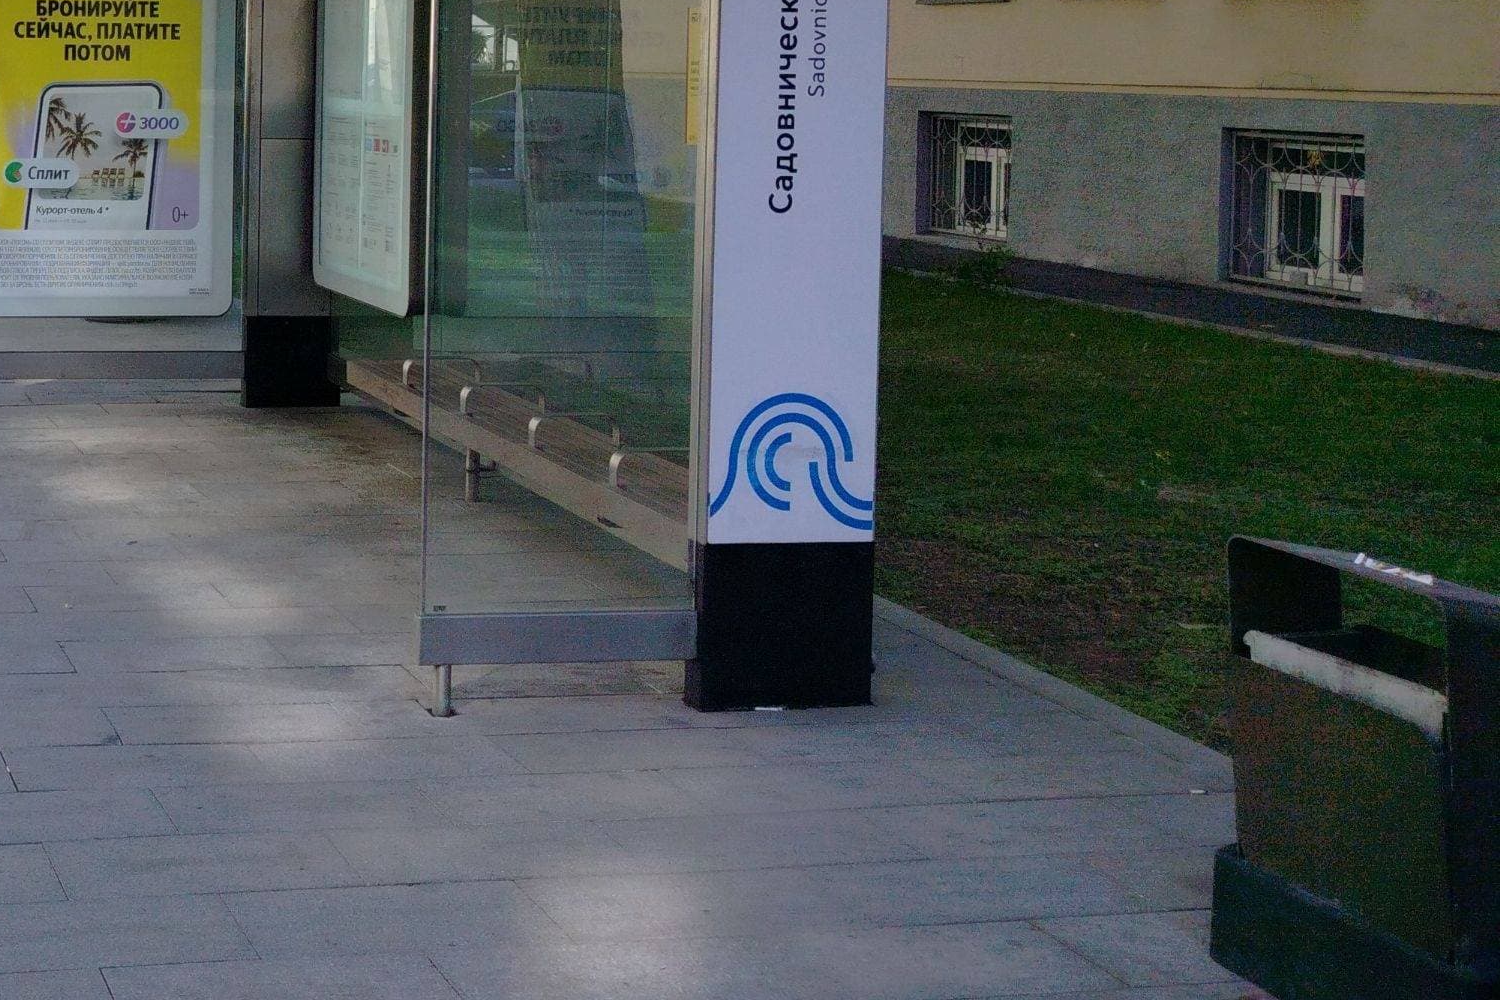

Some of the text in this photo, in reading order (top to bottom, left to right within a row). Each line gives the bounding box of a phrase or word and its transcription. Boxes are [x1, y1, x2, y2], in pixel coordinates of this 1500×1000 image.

[14, 18, 181, 41] СЕЙЧАС, ПЛАТИТЕ
[64, 44, 131, 62] ПОТОМ
[138, 116, 180, 130] 3000
[28, 166, 71, 181] Сплит
[35, 205, 97, 217] Курорт-отель
[172, 206, 189, 223] 0+
